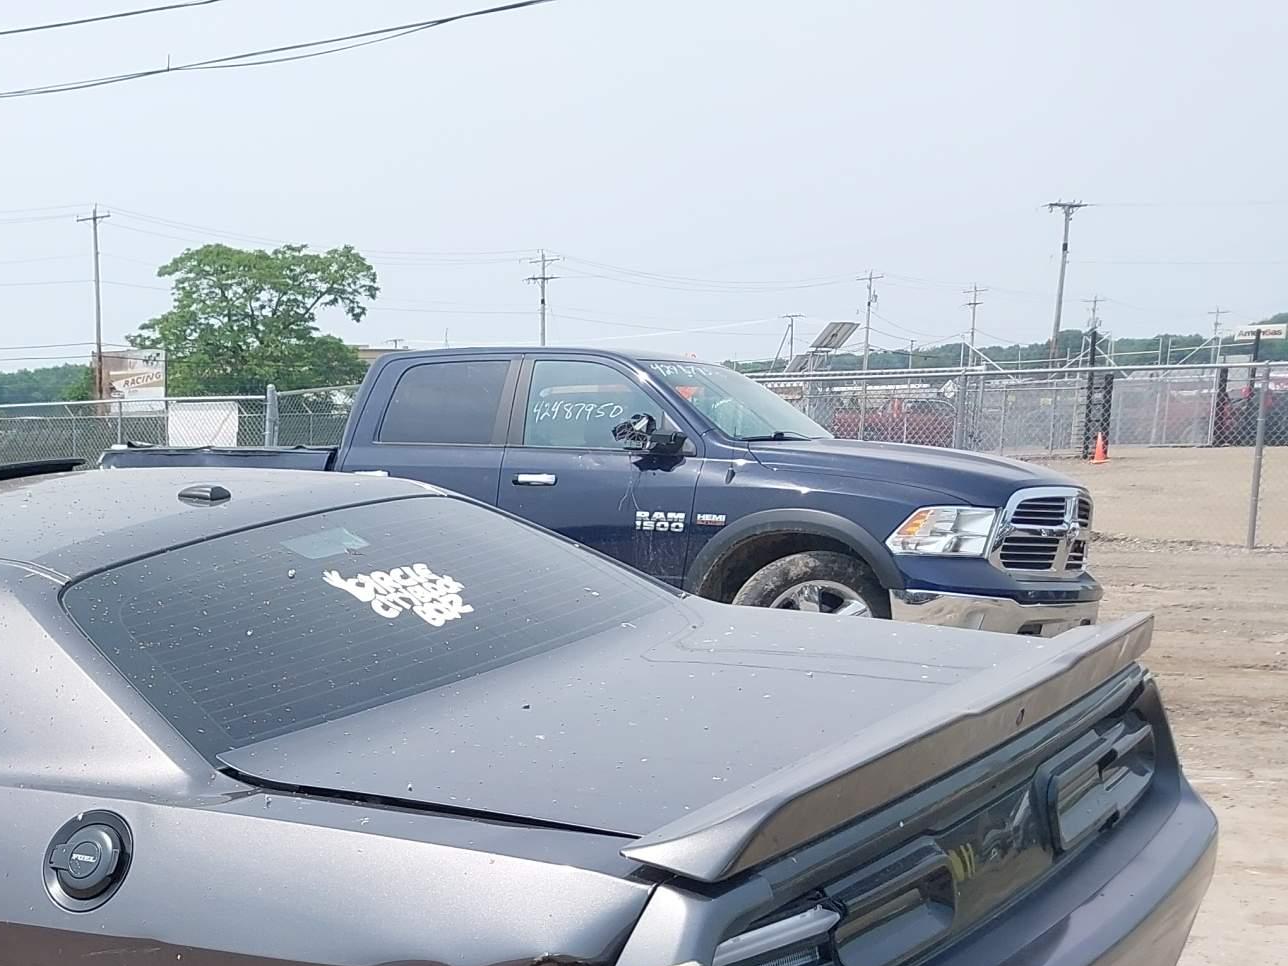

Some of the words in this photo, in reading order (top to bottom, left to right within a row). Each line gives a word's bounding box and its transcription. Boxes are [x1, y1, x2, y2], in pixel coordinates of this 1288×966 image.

[122, 371, 162, 388] RACING
[533, 400, 623, 423] 42487950
[635, 511, 686, 522] RAM
[696, 513, 727, 522] HEMI
[635, 521, 684, 532] 1500
[72, 853, 97, 863] FUEL
